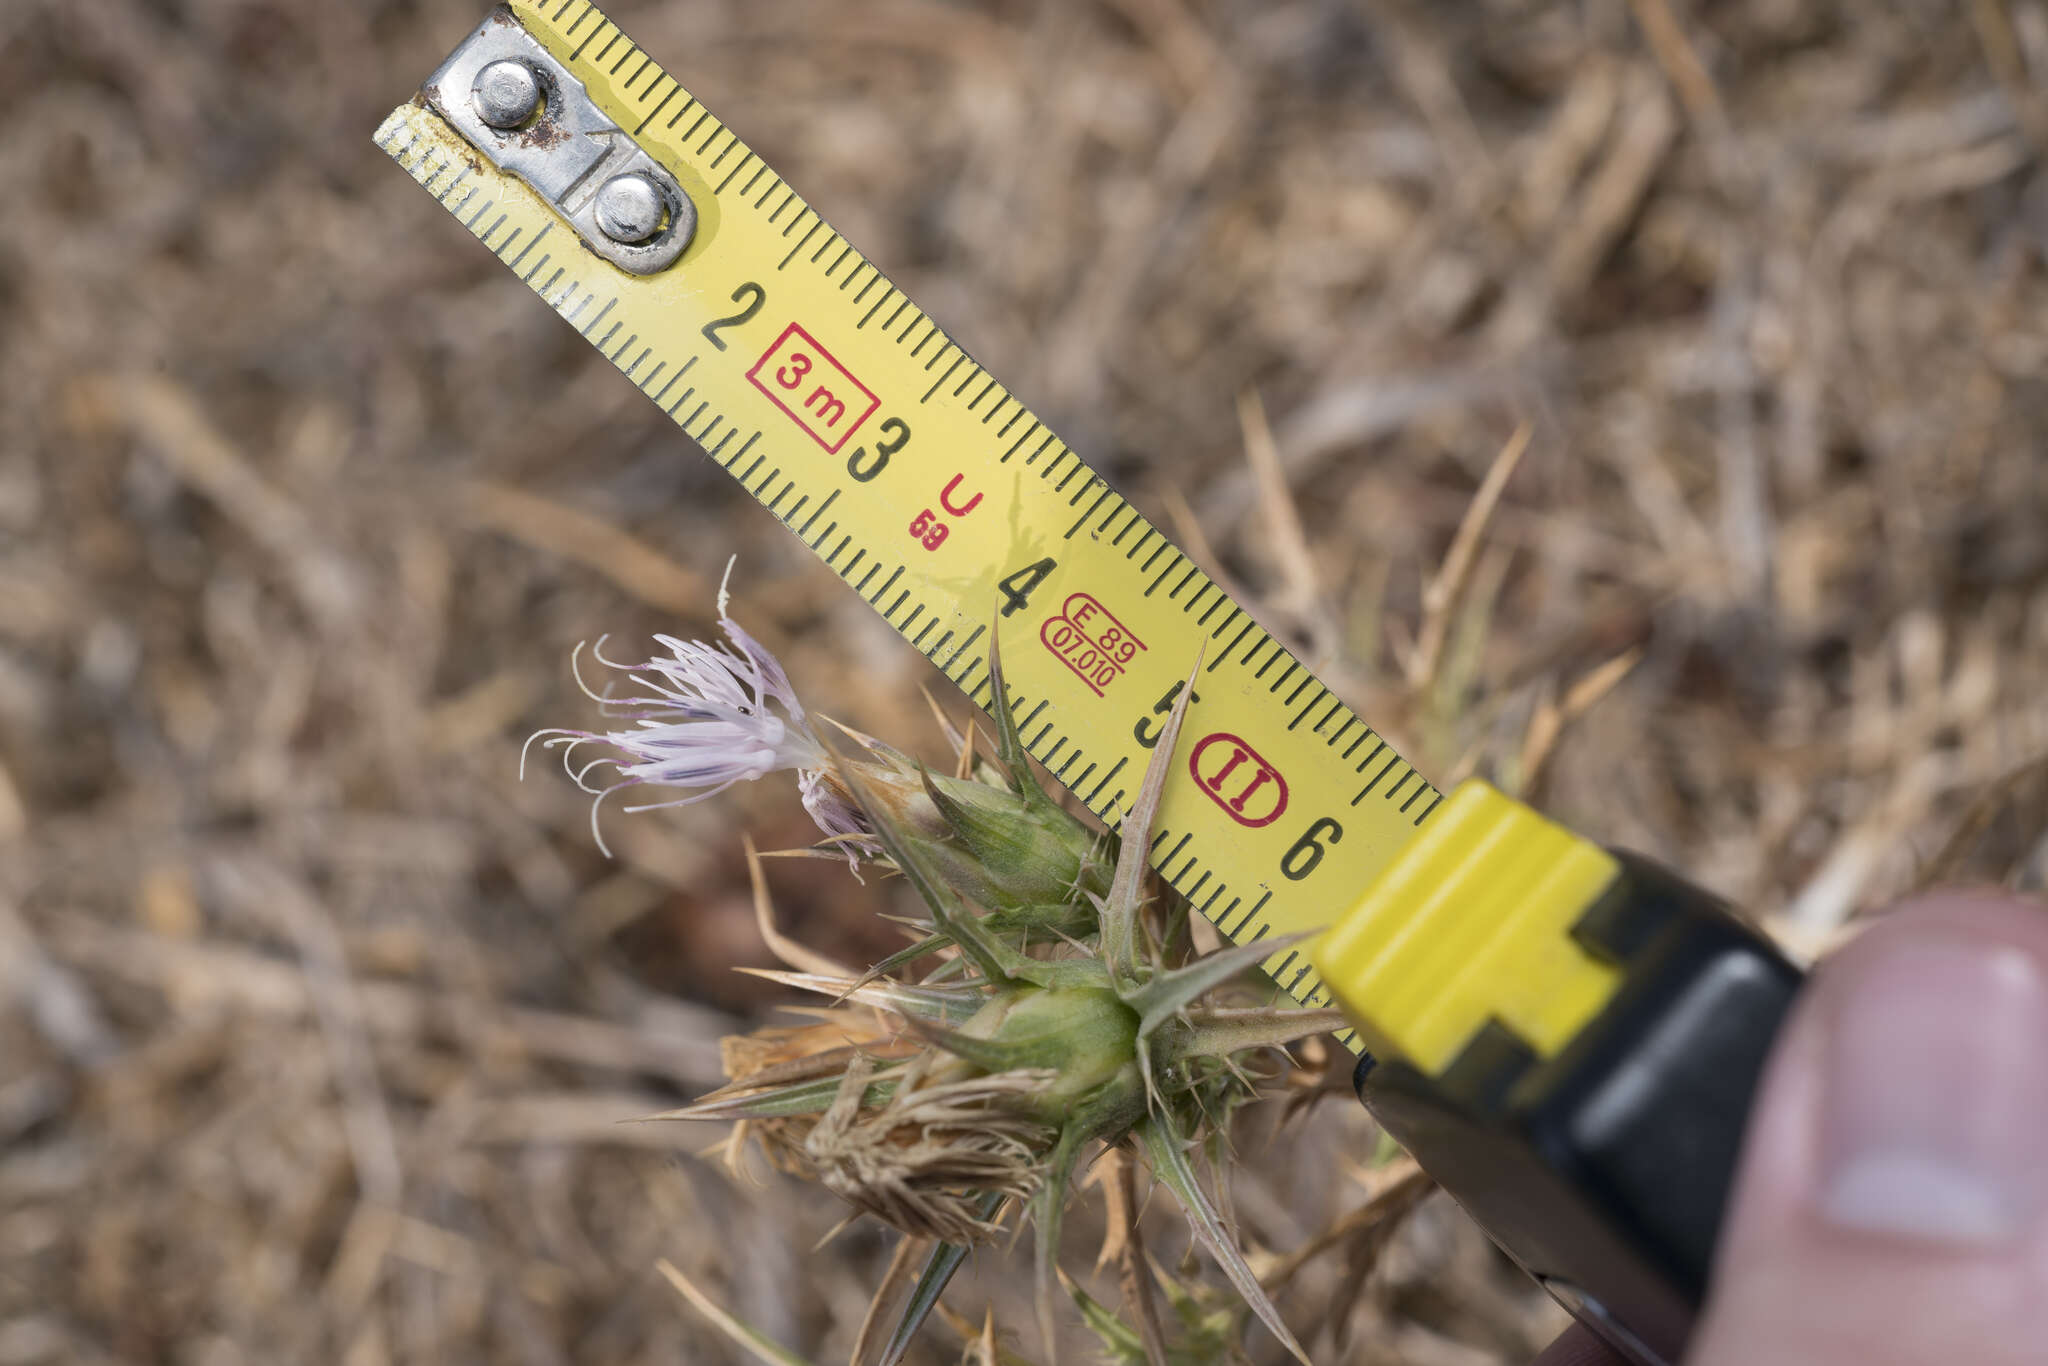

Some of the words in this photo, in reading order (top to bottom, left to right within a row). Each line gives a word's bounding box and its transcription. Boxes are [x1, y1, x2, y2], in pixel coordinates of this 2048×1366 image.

[702, 281, 767, 352] 2
[776, 352, 813, 390] 3
[804, 385, 846, 428] m
[847, 417, 911, 483] 3
[940, 472, 984, 518] U
[998, 557, 1058, 618] 4
[1052, 626, 1116, 688] 07.010
[1072, 602, 1098, 630] E
[1099, 627, 1137, 664] 89
[1134, 679, 1200, 749] 5
[1208, 748, 1272, 812] II
[1280, 816, 1343, 881] 6
